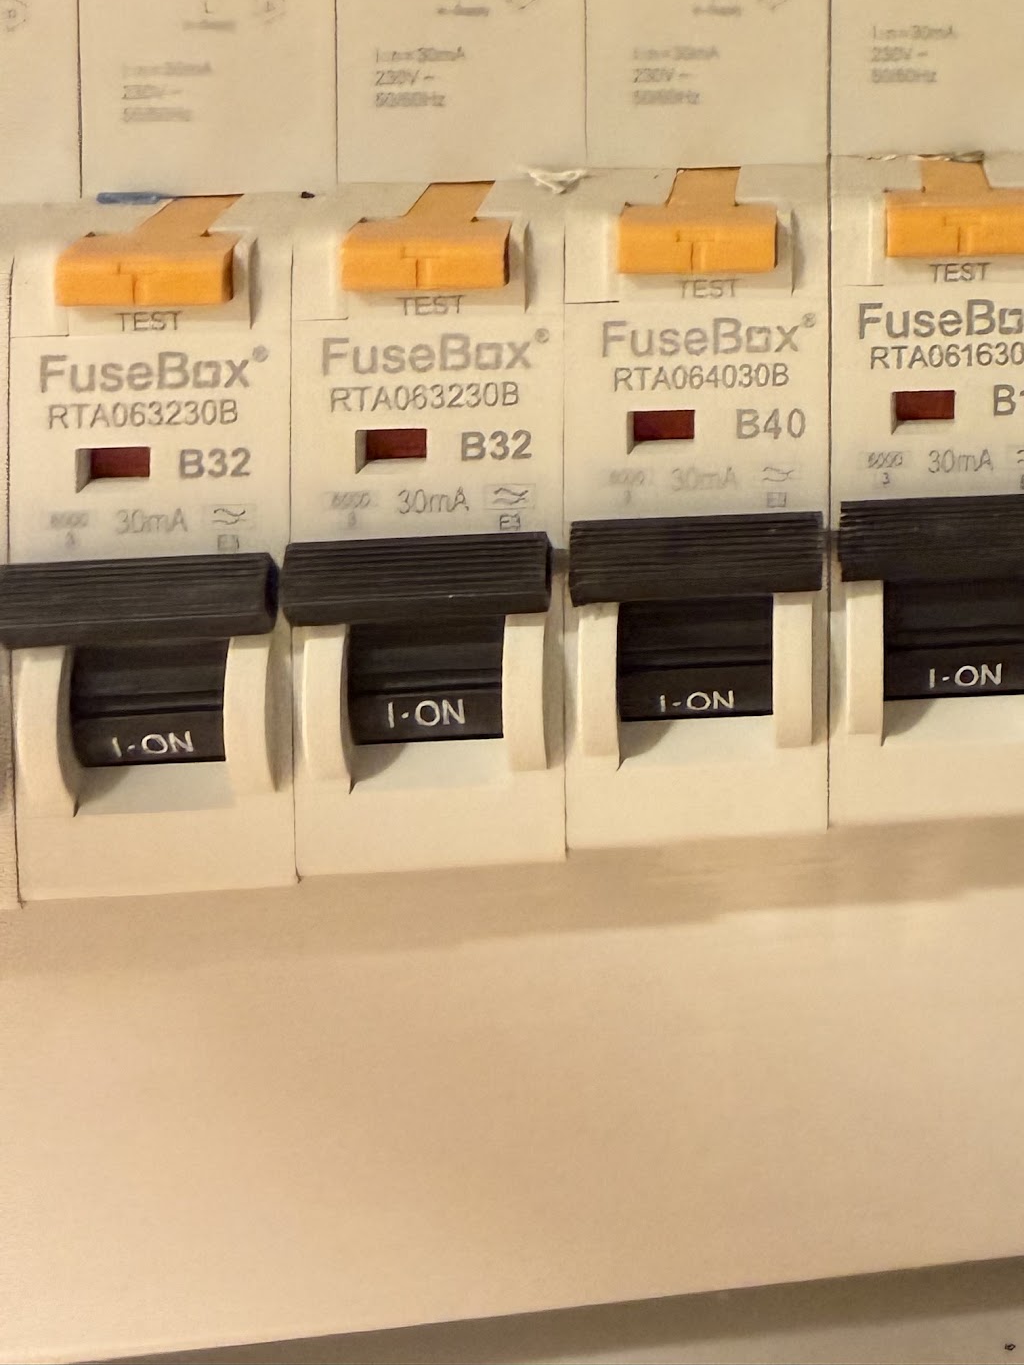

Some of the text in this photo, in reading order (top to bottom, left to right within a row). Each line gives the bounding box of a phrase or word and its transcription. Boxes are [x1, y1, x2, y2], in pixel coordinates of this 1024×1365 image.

[929, 262, 992, 283] TEST
[678, 278, 741, 299] TEST
[396, 295, 465, 316] TEST
[116, 310, 182, 332] TEST
[614, 363, 789, 392] RTA064030B
[330, 382, 520, 413] RTA063230B
[48, 399, 238, 430] RTA063230B
[736, 408, 806, 440] B40
[461, 430, 533, 462] B32
[179, 448, 252, 479] B32
[928, 449, 993, 474] 30mA
[397, 486, 470, 514] 30mA
[116, 508, 188, 535] 30mA
